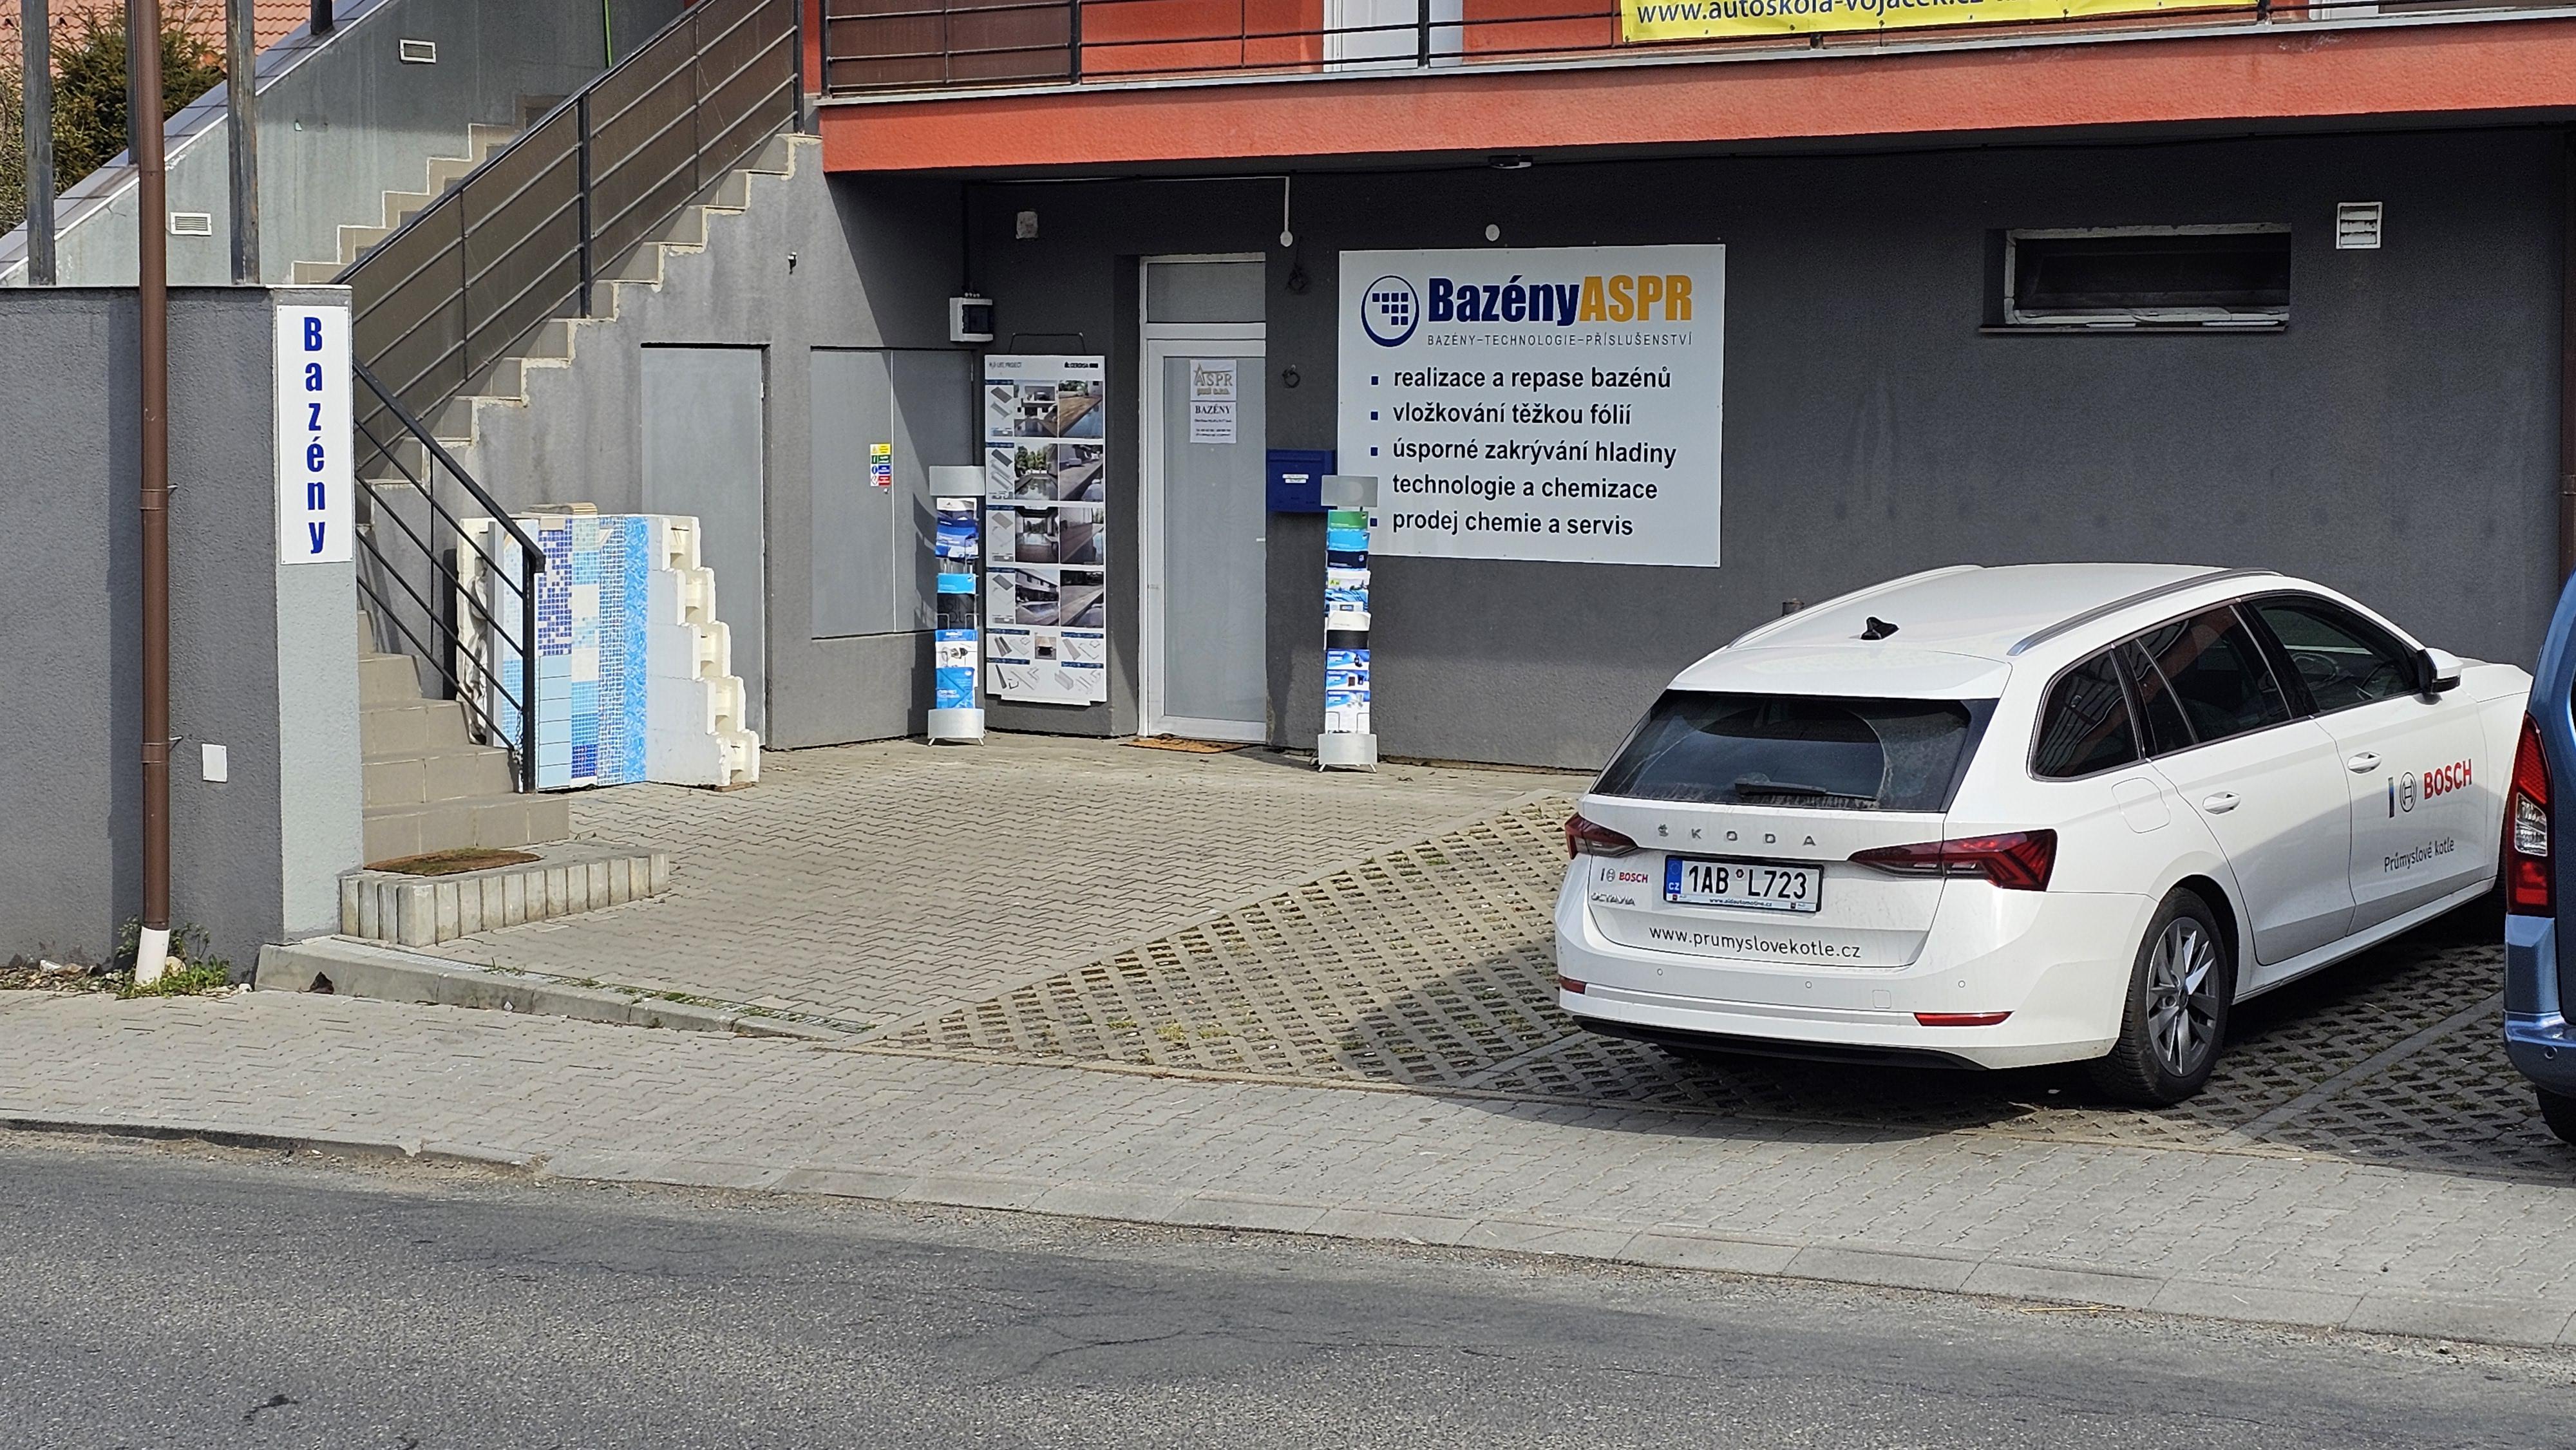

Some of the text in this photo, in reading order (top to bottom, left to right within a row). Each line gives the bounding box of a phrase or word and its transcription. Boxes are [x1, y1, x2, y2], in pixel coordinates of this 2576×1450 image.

[1428, 274, 1692, 326] BazényASPR
[1193, 363, 1233, 386] ASPR
[1394, 366, 1671, 393] realizace a repase bazénů
[1195, 404, 1231, 414] BAZÉNY
[1392, 402, 1631, 425] vložkování těžkou fólií
[304, 317, 325, 554] Bazény
[1393, 437, 1676, 469] úsporné zakrývání hladiny
[1392, 474, 1658, 501] technologie a chemizace
[1392, 509, 1633, 536] prodej chemie a servis
[2423, 758, 2472, 800] BOSCH
[1658, 824, 1816, 847] ŠKODA
[2434, 836, 2455, 856] kotle
[1619, 872, 1649, 883] BOSCH
[1668, 882, 1680, 890] CZ
[1689, 865, 1808, 899] 1AB L723
[1649, 927, 1861, 958] www.prumyslovekotle.cz
